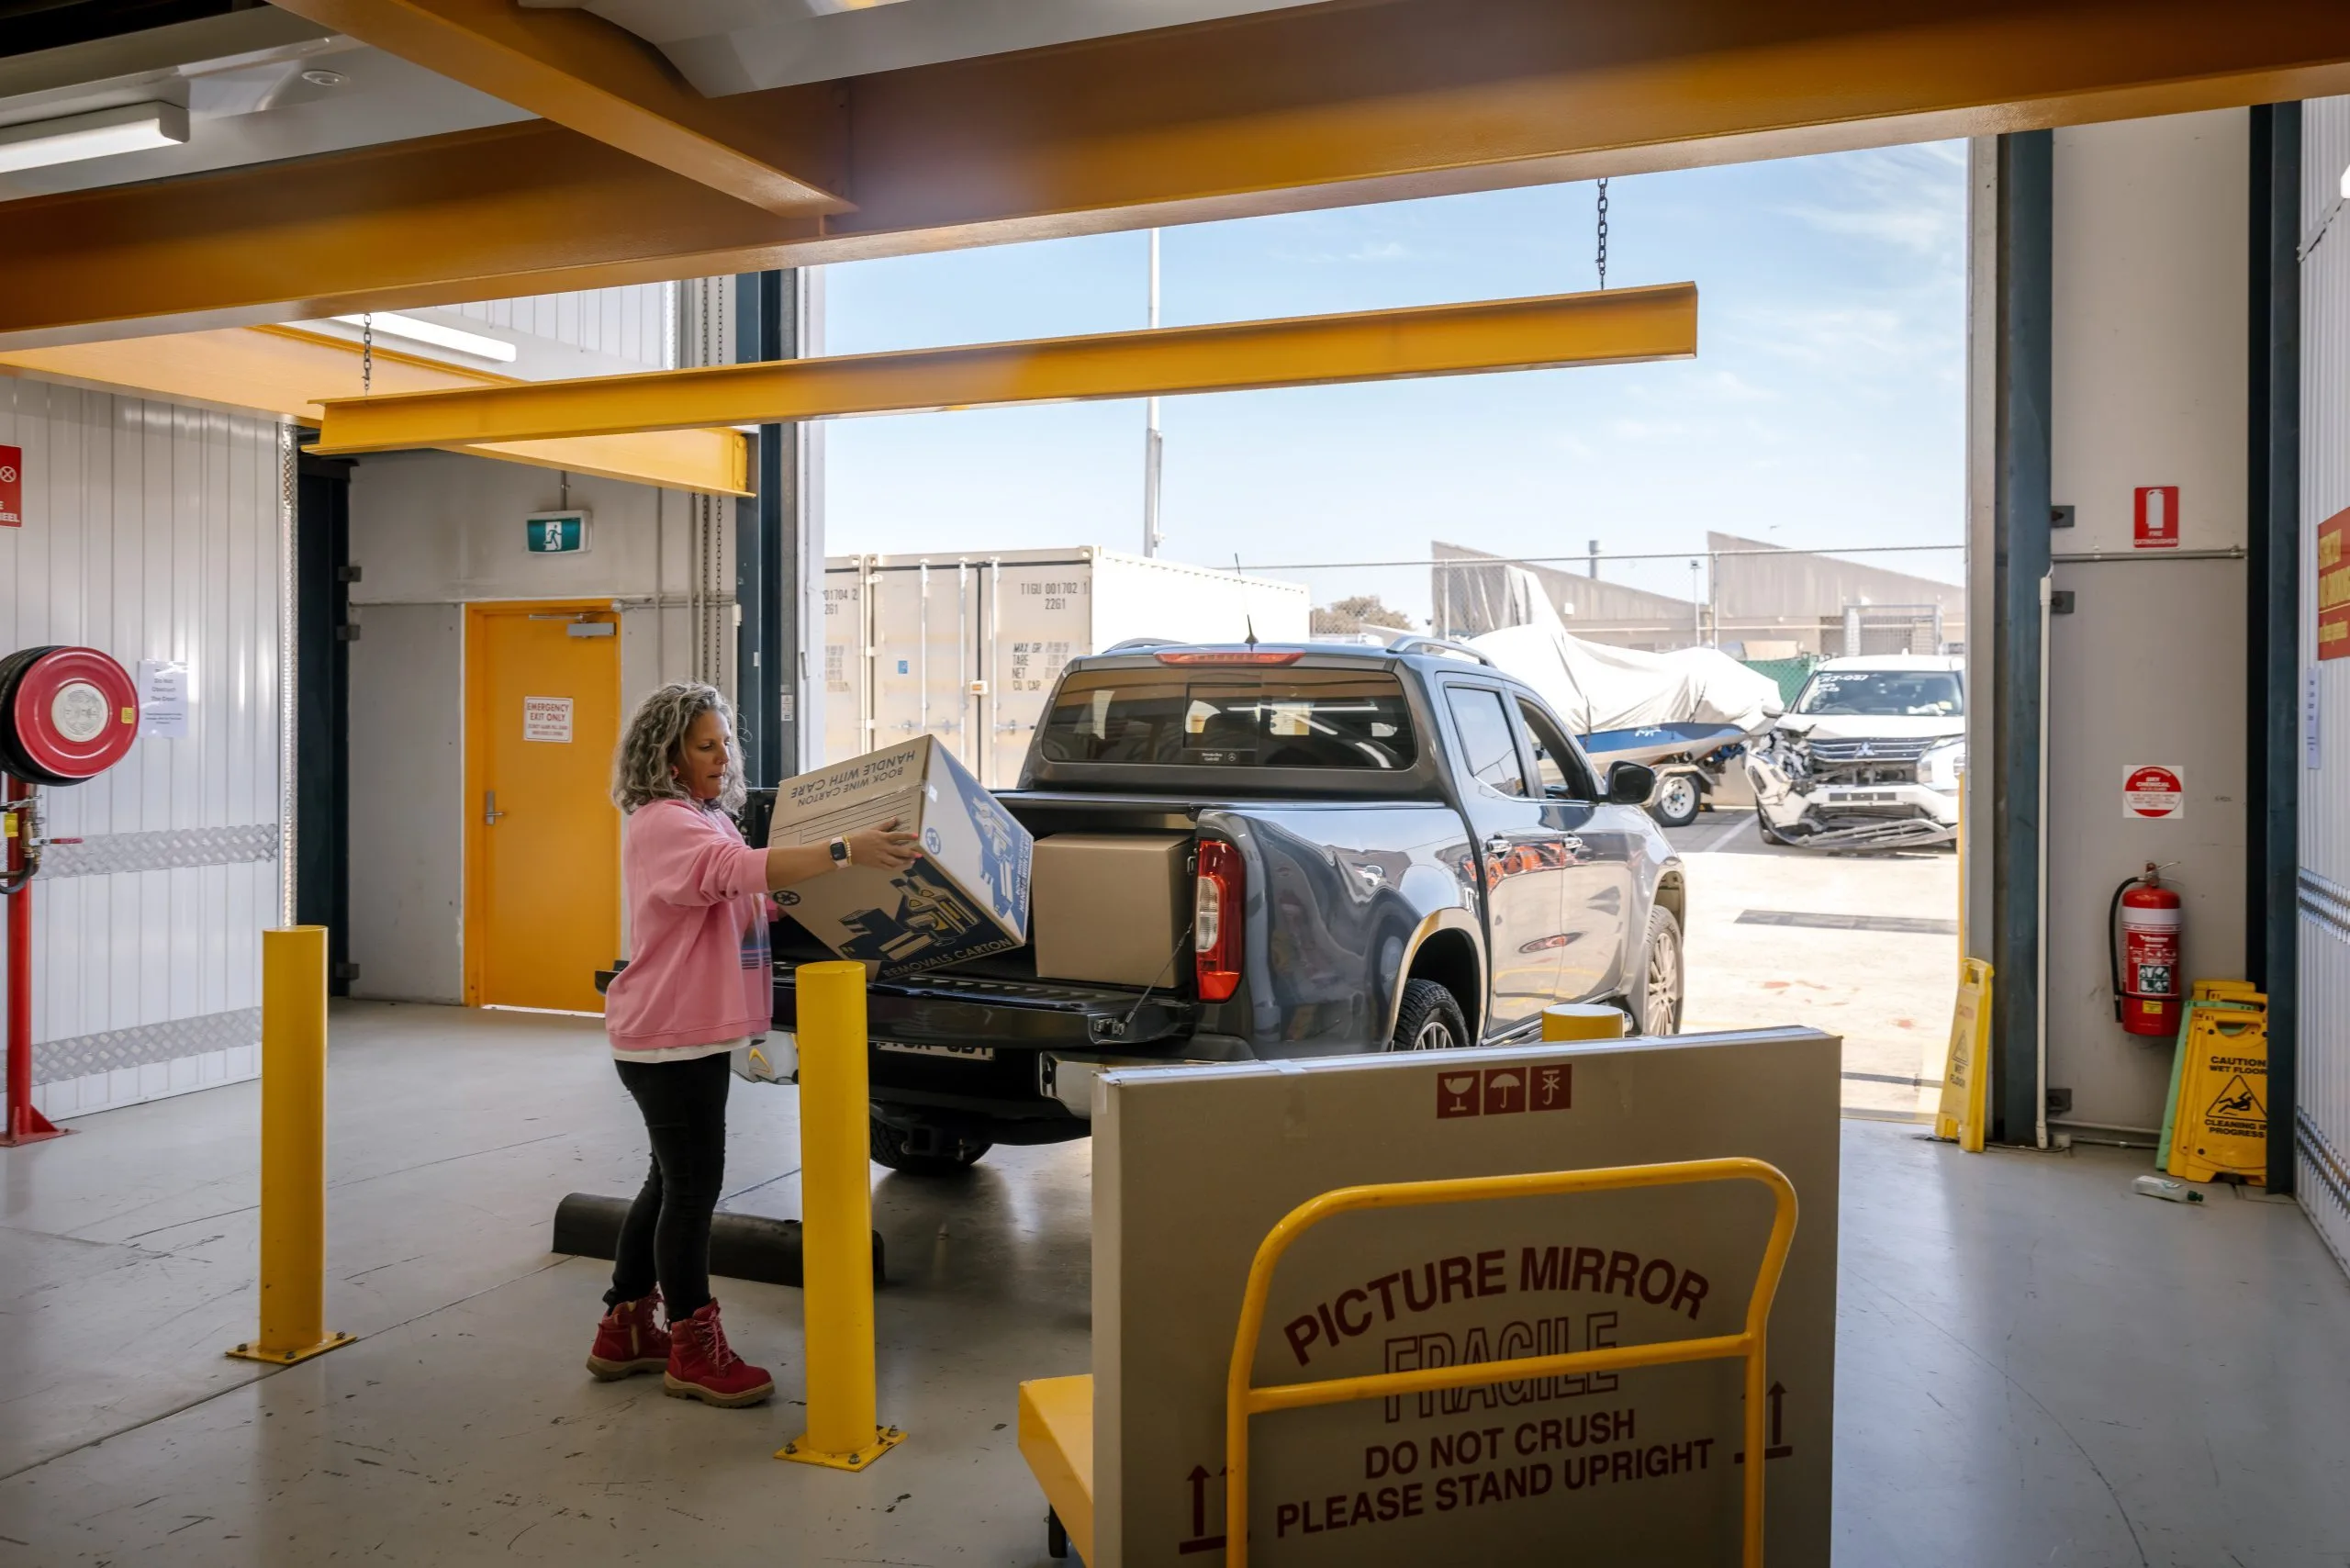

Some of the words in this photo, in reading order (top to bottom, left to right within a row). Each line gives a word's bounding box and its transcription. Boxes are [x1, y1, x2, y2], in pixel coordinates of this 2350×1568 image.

[527, 702, 569, 712] EMERGENCY
[530, 712, 544, 721] EXIT
[546, 713, 565, 722] ONLY
[863, 750, 915, 776] HANDLE
[829, 767, 859, 787] WITH
[872, 767, 903, 782] BOOK
[790, 778, 825, 799] CARE
[843, 778, 869, 793] WINE
[797, 788, 842, 808] CARTON
[883, 953, 953, 978] REMOVALS
[954, 938, 1013, 960] CARTON
[2210, 1056, 2266, 1067] CAUTION
[2210, 1064, 2231, 1073] WET
[2204, 1118, 2255, 1129] CLEANING
[2209, 1126, 2265, 1138] PROGRESS
[1284, 1249, 1506, 1367] PICTURE
[1520, 1246, 1709, 1321] MIRROR
[1384, 1311, 1618, 1424] FRAGILE
[1366, 1440, 1418, 1479] DO
[1430, 1427, 1504, 1469] NOT
[1515, 1408, 1635, 1455] CRUSH
[1277, 1483, 1424, 1538] PLEASE
[1436, 1463, 1552, 1511] STAND
[1564, 1438, 1714, 1490] UPRIGHT
